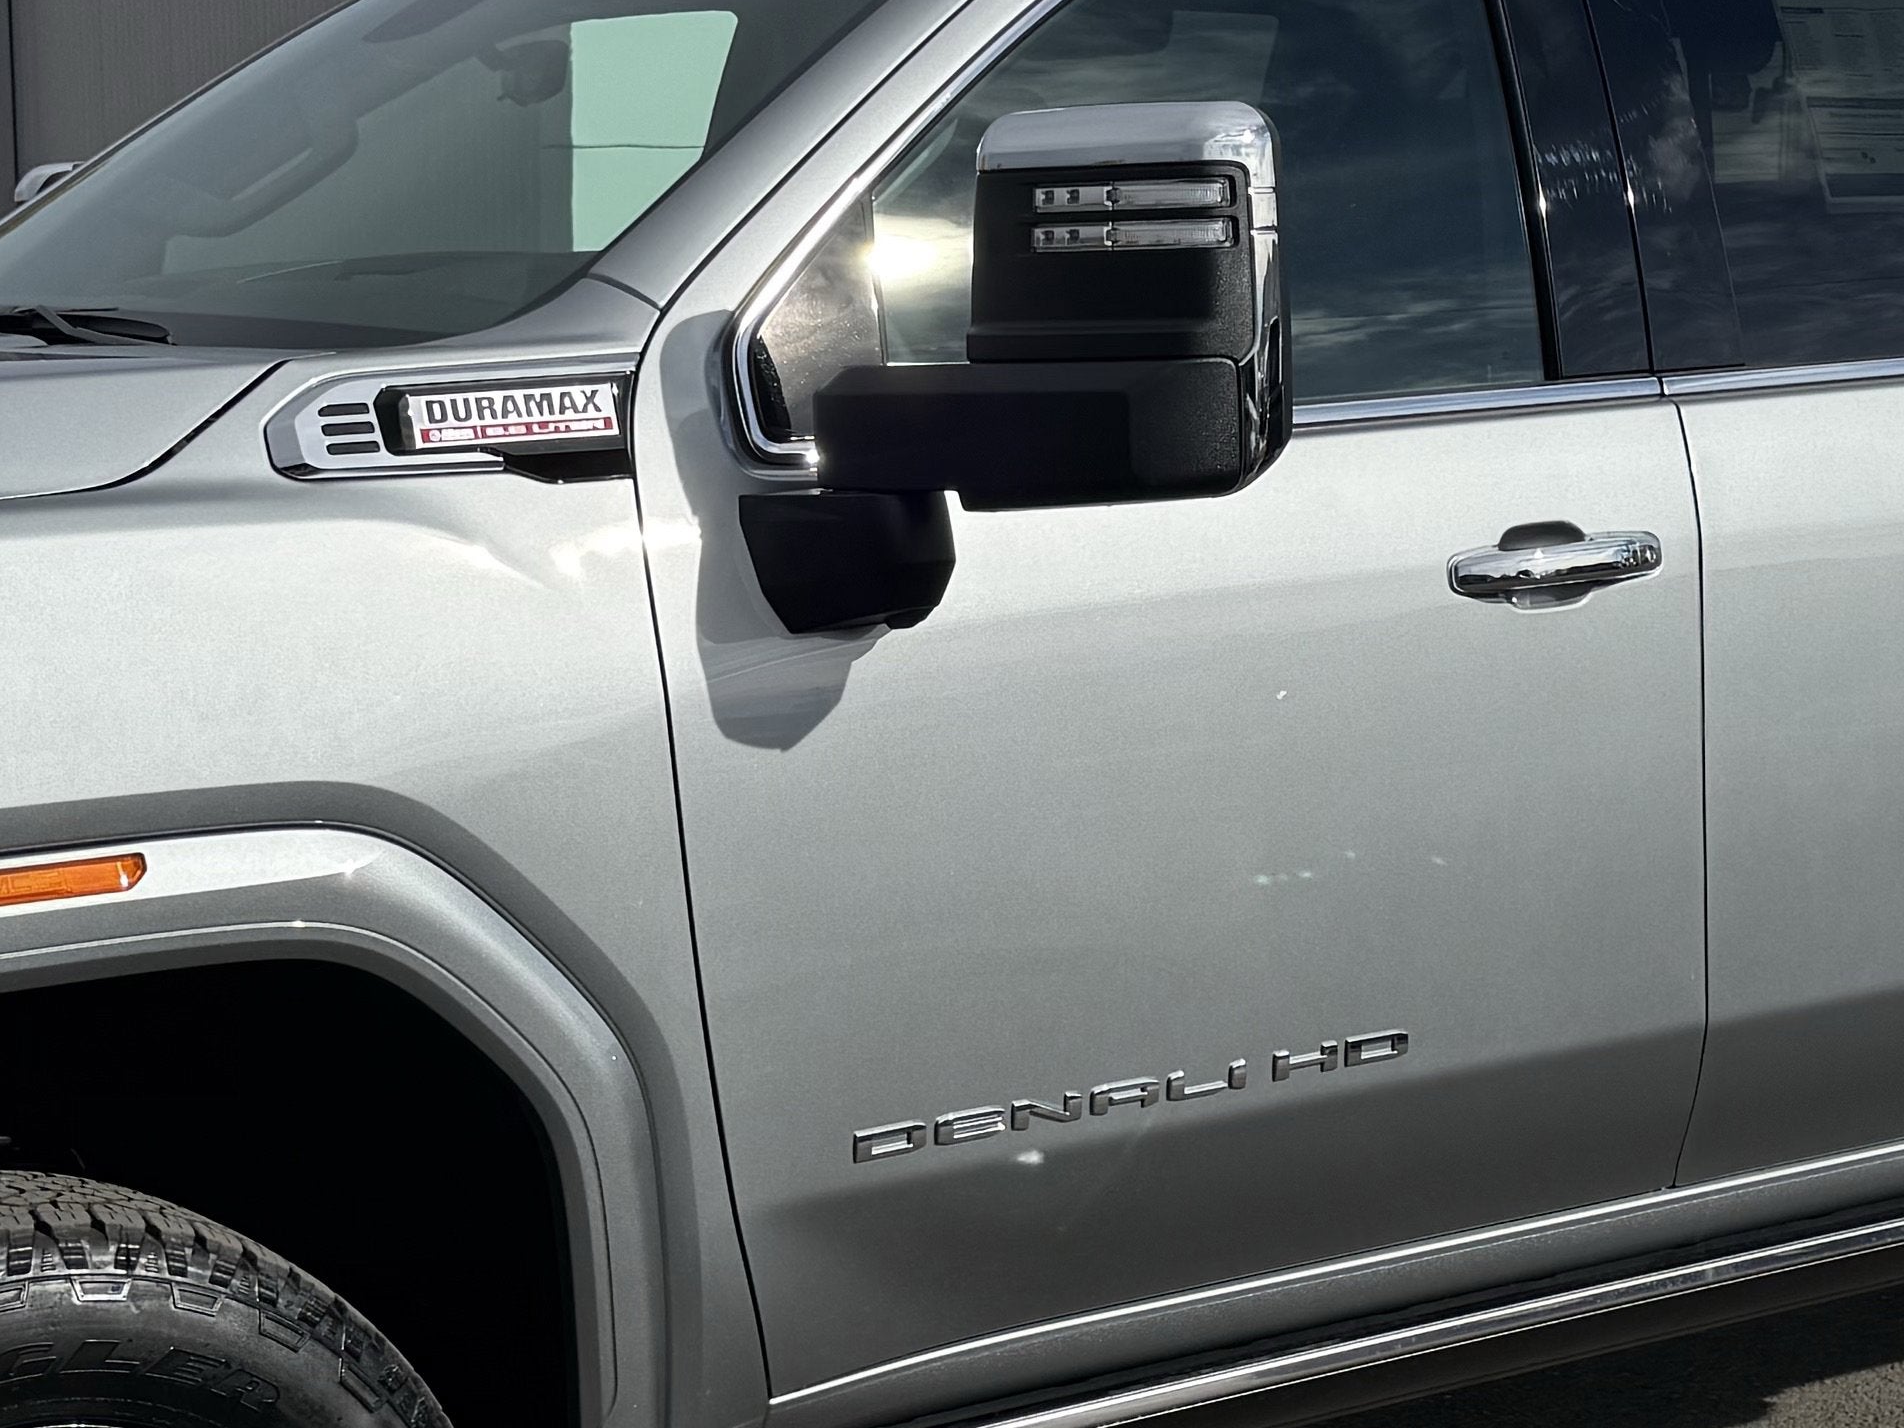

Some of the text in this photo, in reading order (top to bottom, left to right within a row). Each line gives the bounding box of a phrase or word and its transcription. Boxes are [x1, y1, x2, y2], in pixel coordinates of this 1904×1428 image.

[424, 388, 604, 424] DURAMAX
[852, 1028, 1410, 1164] DENALI HD
